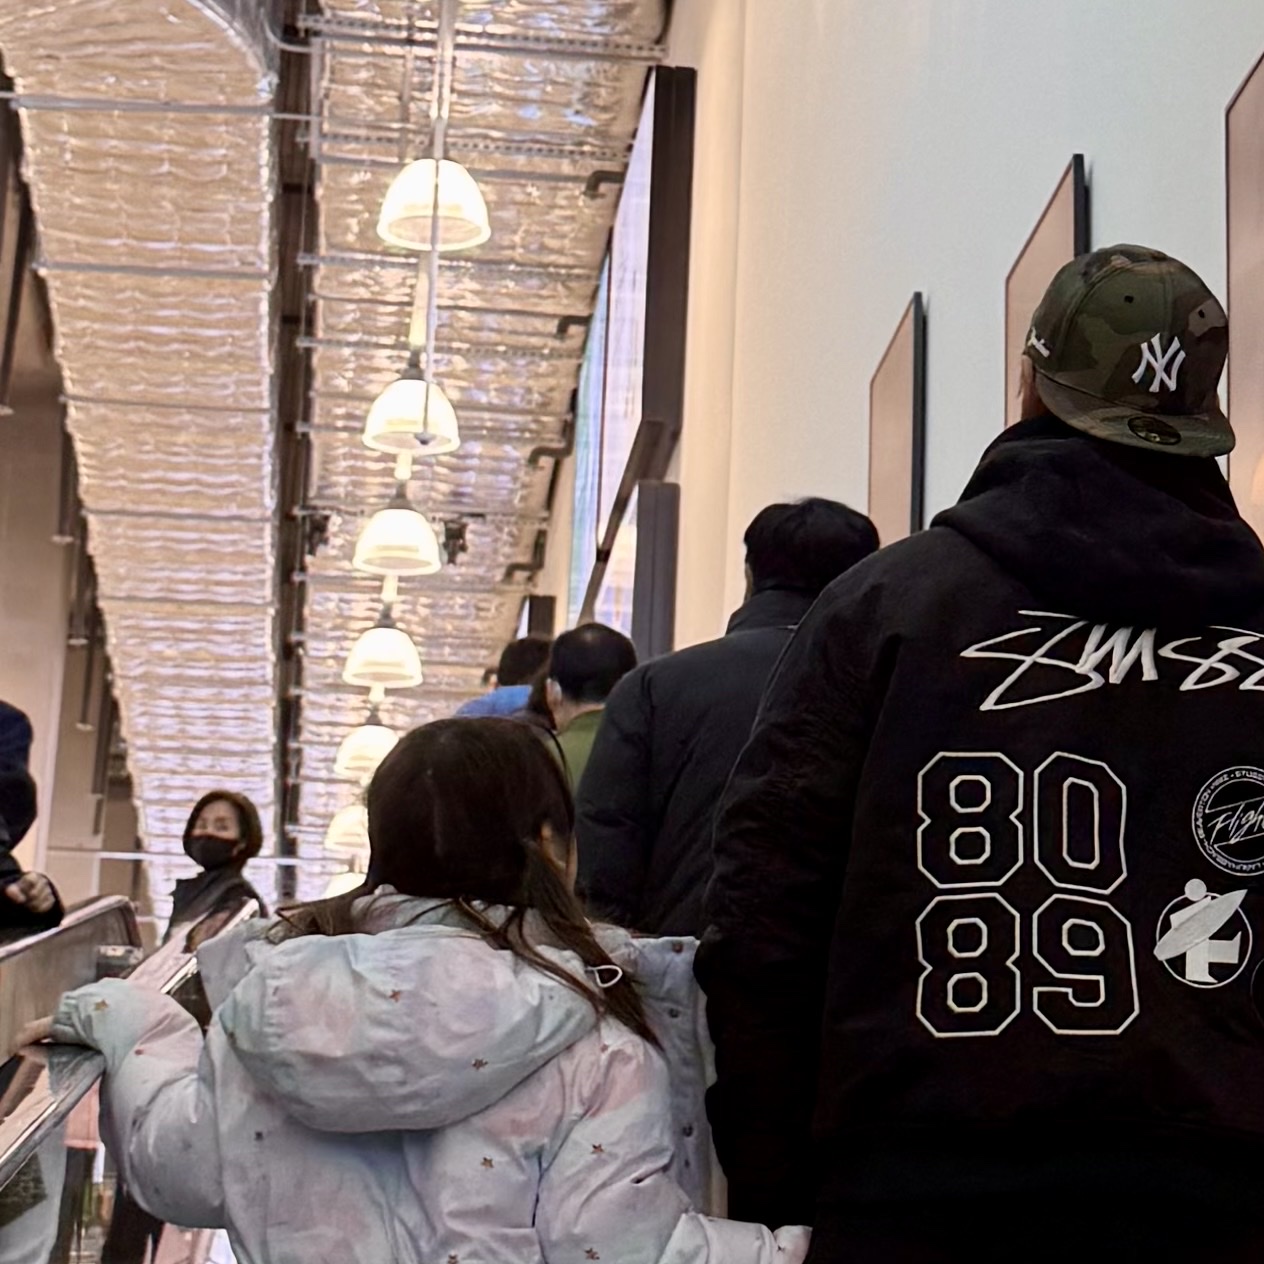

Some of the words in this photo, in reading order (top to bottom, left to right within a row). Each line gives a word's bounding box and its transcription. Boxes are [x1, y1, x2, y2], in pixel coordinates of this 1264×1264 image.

[1131, 332, 1187, 393] NY
[917, 751, 1127, 895] 80
[915, 892, 1140, 1038] 89
